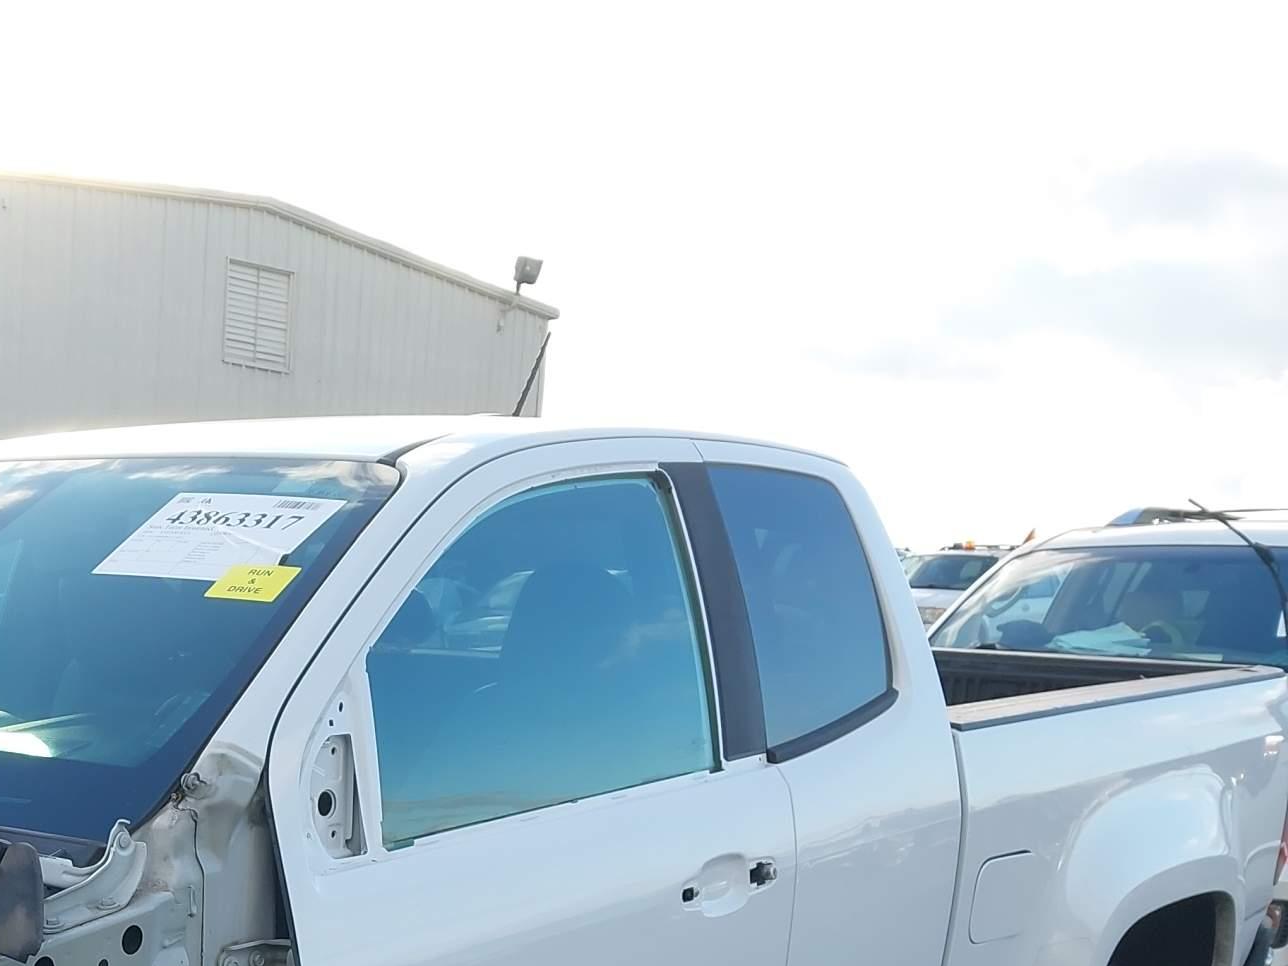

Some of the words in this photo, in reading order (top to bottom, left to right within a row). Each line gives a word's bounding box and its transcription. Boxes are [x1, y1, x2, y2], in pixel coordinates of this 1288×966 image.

[165, 508, 305, 531] 43863317
[247, 568, 274, 578] RUN
[226, 584, 264, 595] DRIVE
